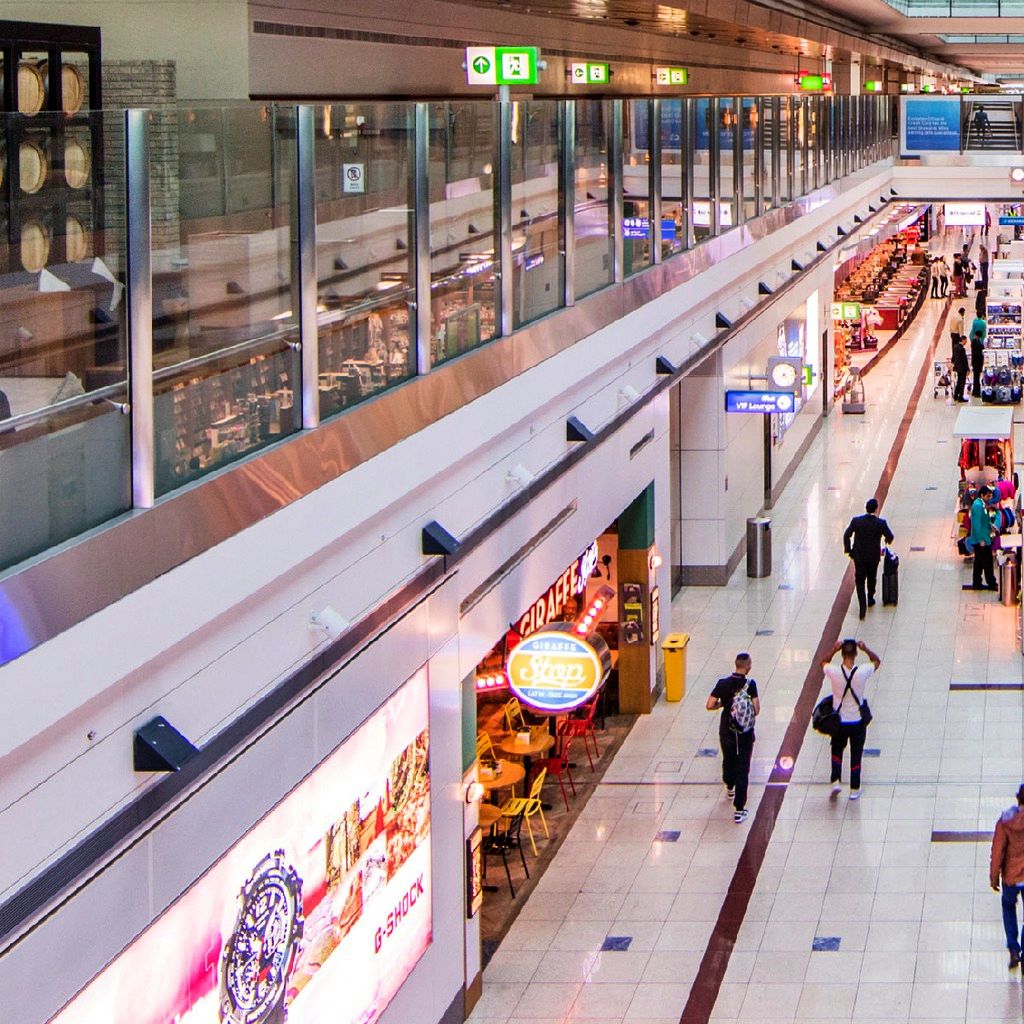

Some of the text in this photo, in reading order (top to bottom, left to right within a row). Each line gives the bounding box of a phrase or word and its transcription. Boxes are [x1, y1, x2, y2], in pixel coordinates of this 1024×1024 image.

[749, 402, 775, 411] Lounge
[520, 559, 579, 639] GIRAFFE
[532, 641, 577, 652] GIRAFFE
[374, 873, 424, 954] G-SHOCK
